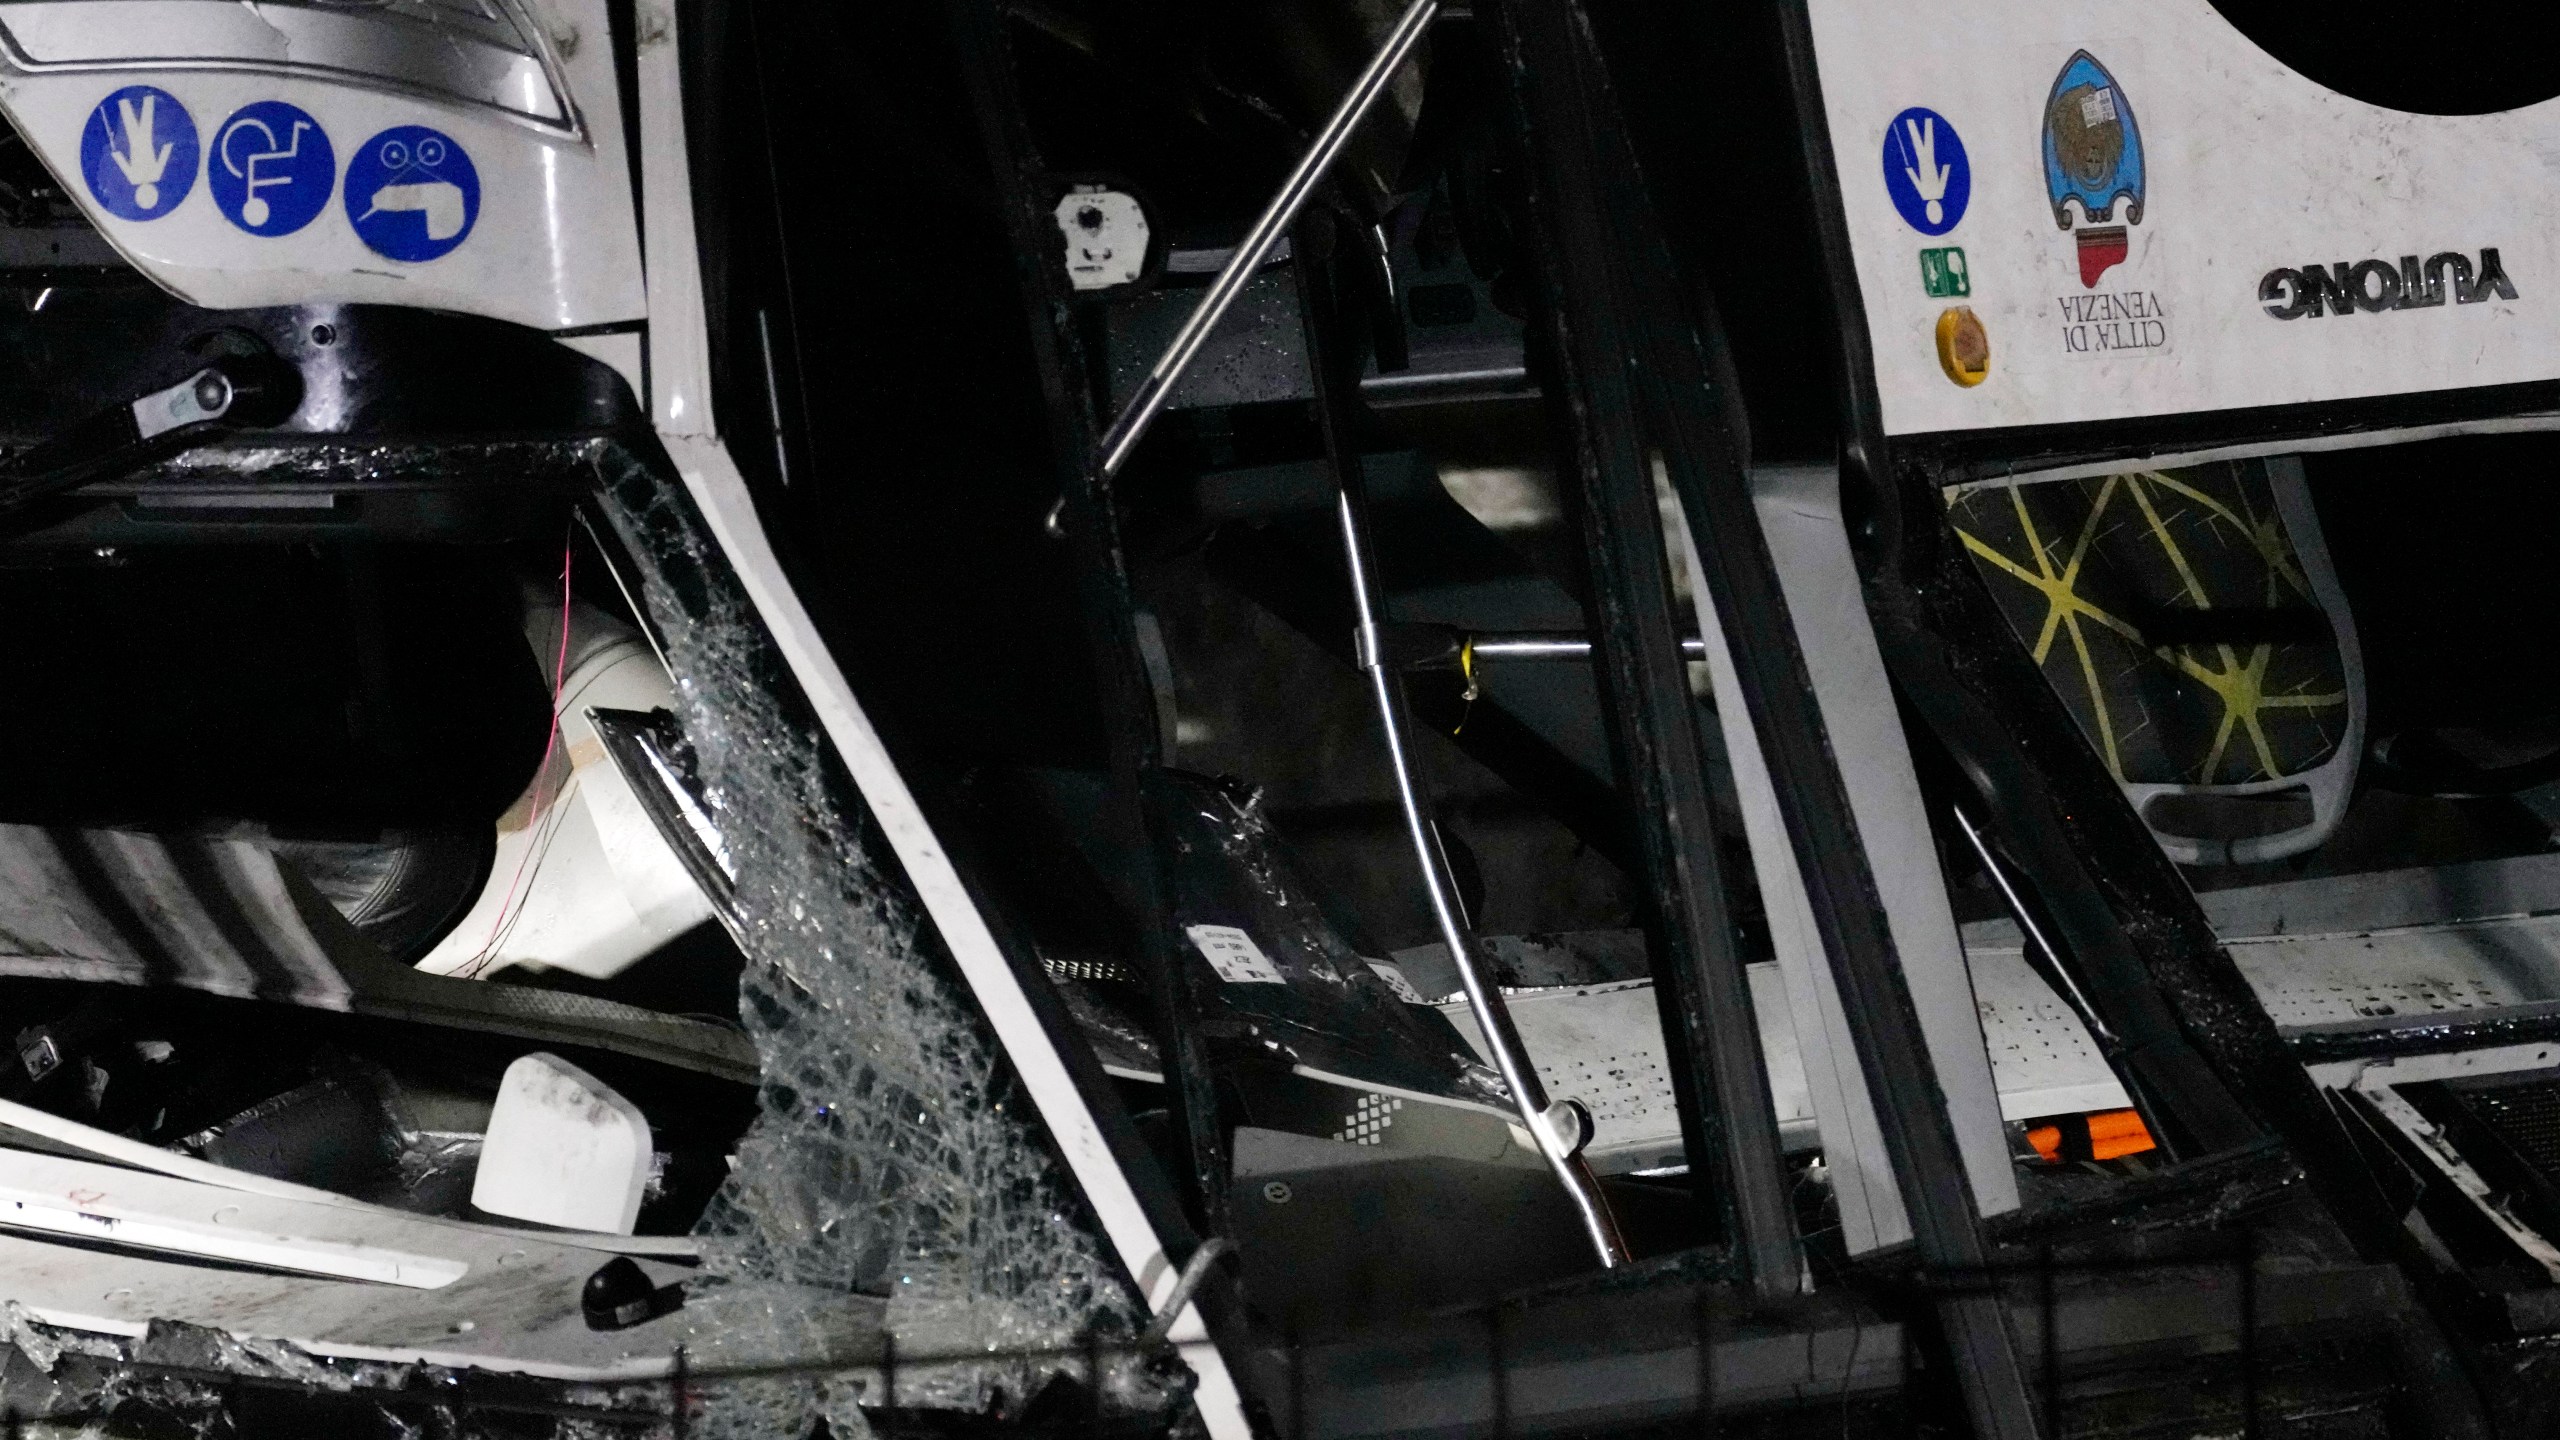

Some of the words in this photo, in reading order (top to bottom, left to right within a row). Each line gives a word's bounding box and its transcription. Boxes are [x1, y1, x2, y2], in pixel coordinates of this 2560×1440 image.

[2258, 247, 2520, 321] YUTONG
[2058, 291, 2164, 322] VENEZIA
[2062, 325, 2089, 353] DI
